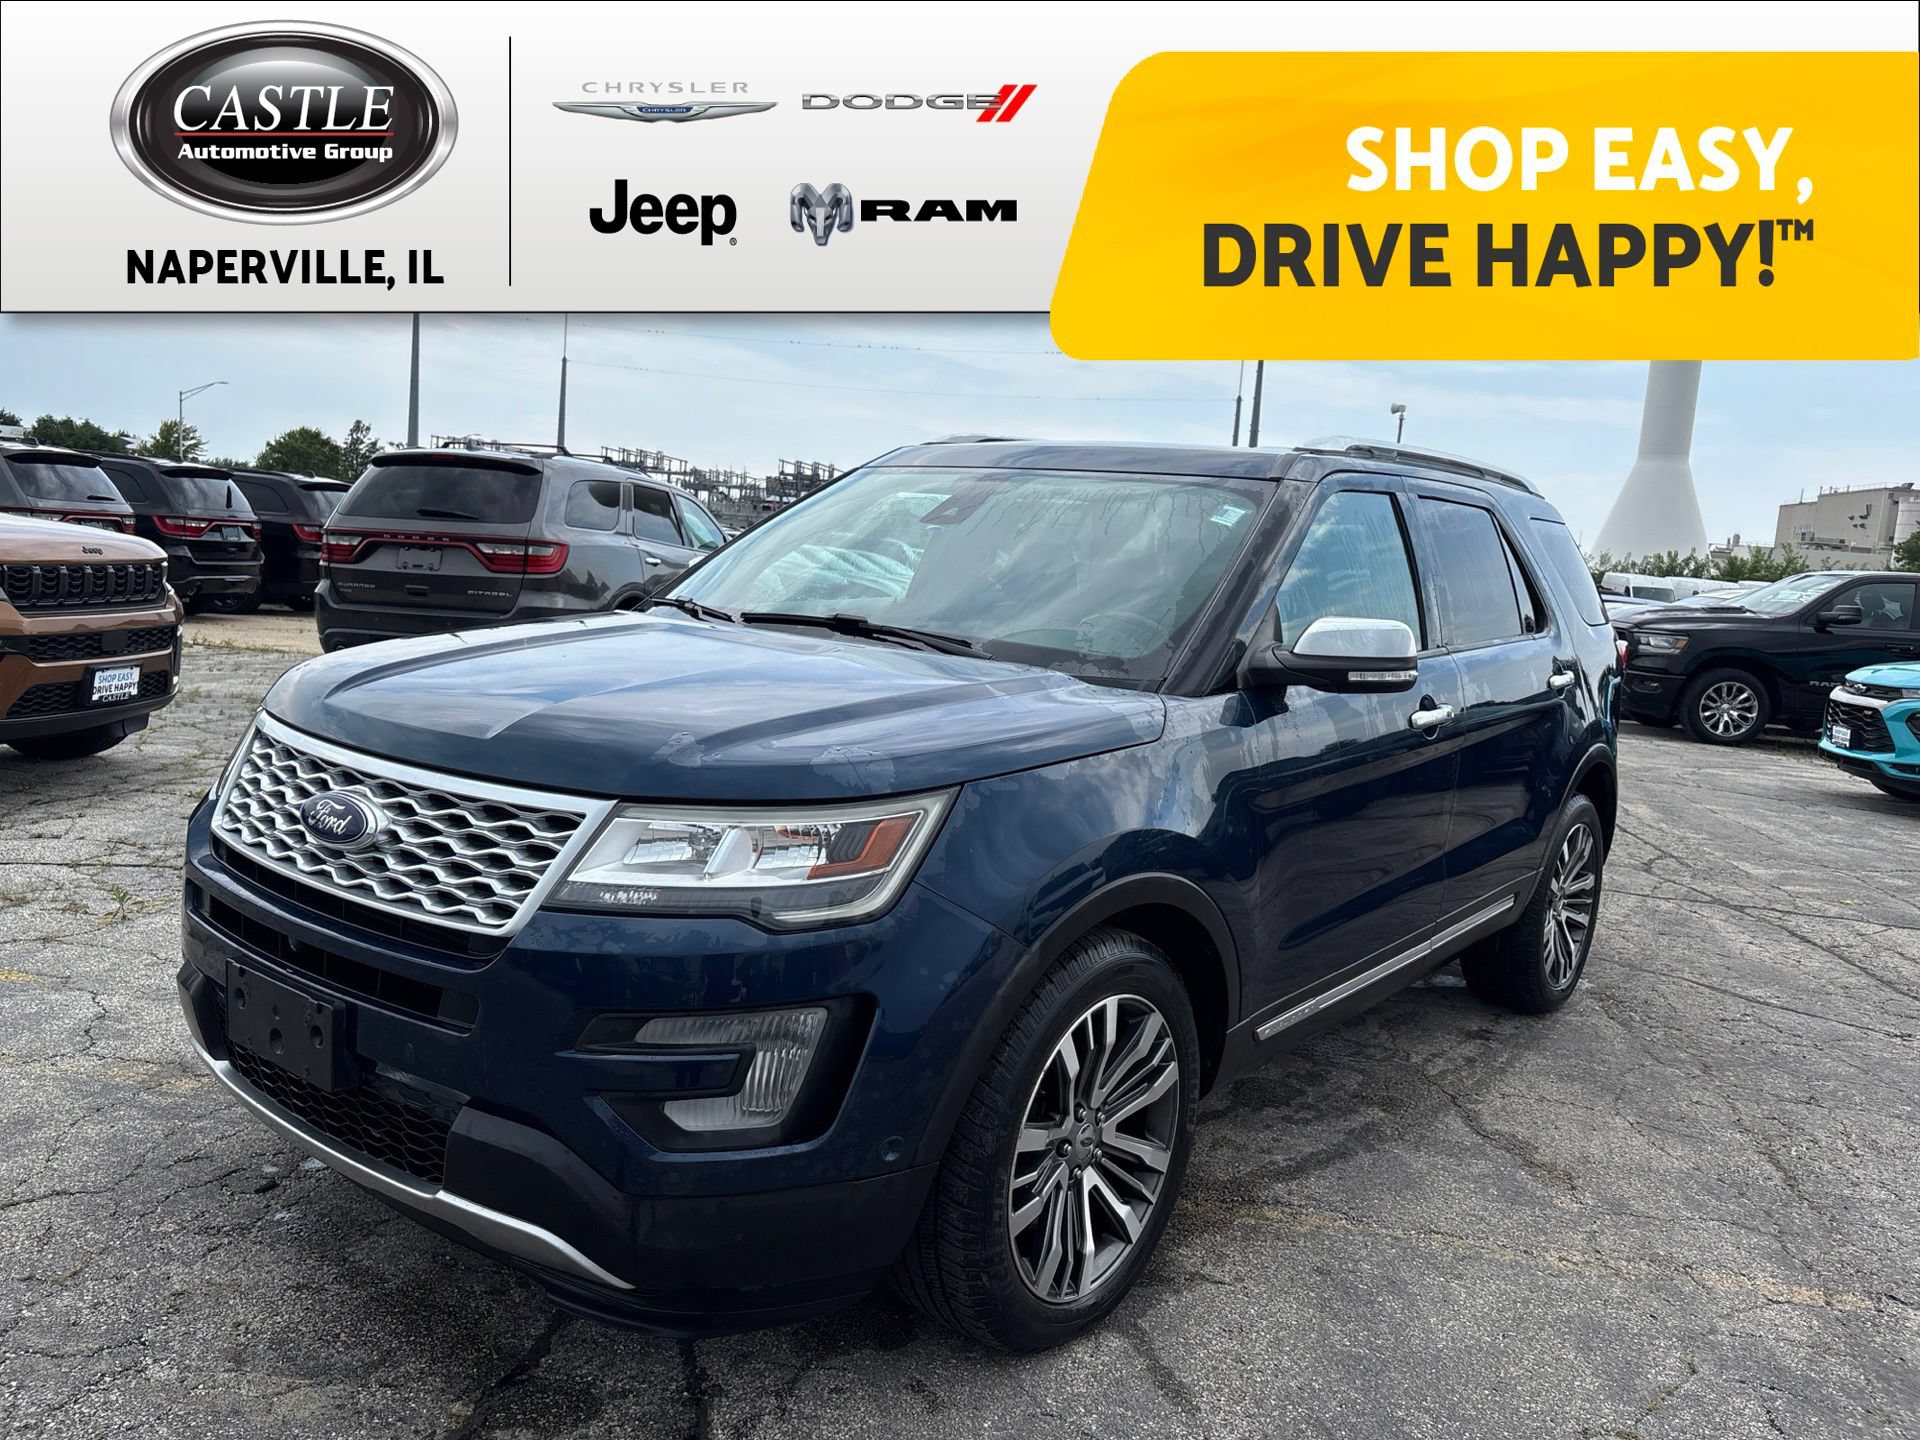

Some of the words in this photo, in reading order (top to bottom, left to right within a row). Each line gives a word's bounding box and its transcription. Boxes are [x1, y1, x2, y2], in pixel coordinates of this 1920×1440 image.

[97, 674, 117, 685] SHOP
[93, 684, 113, 695] DRIVE
[103, 691, 129, 702] CASTLE
[308, 799, 353, 835] Ford
